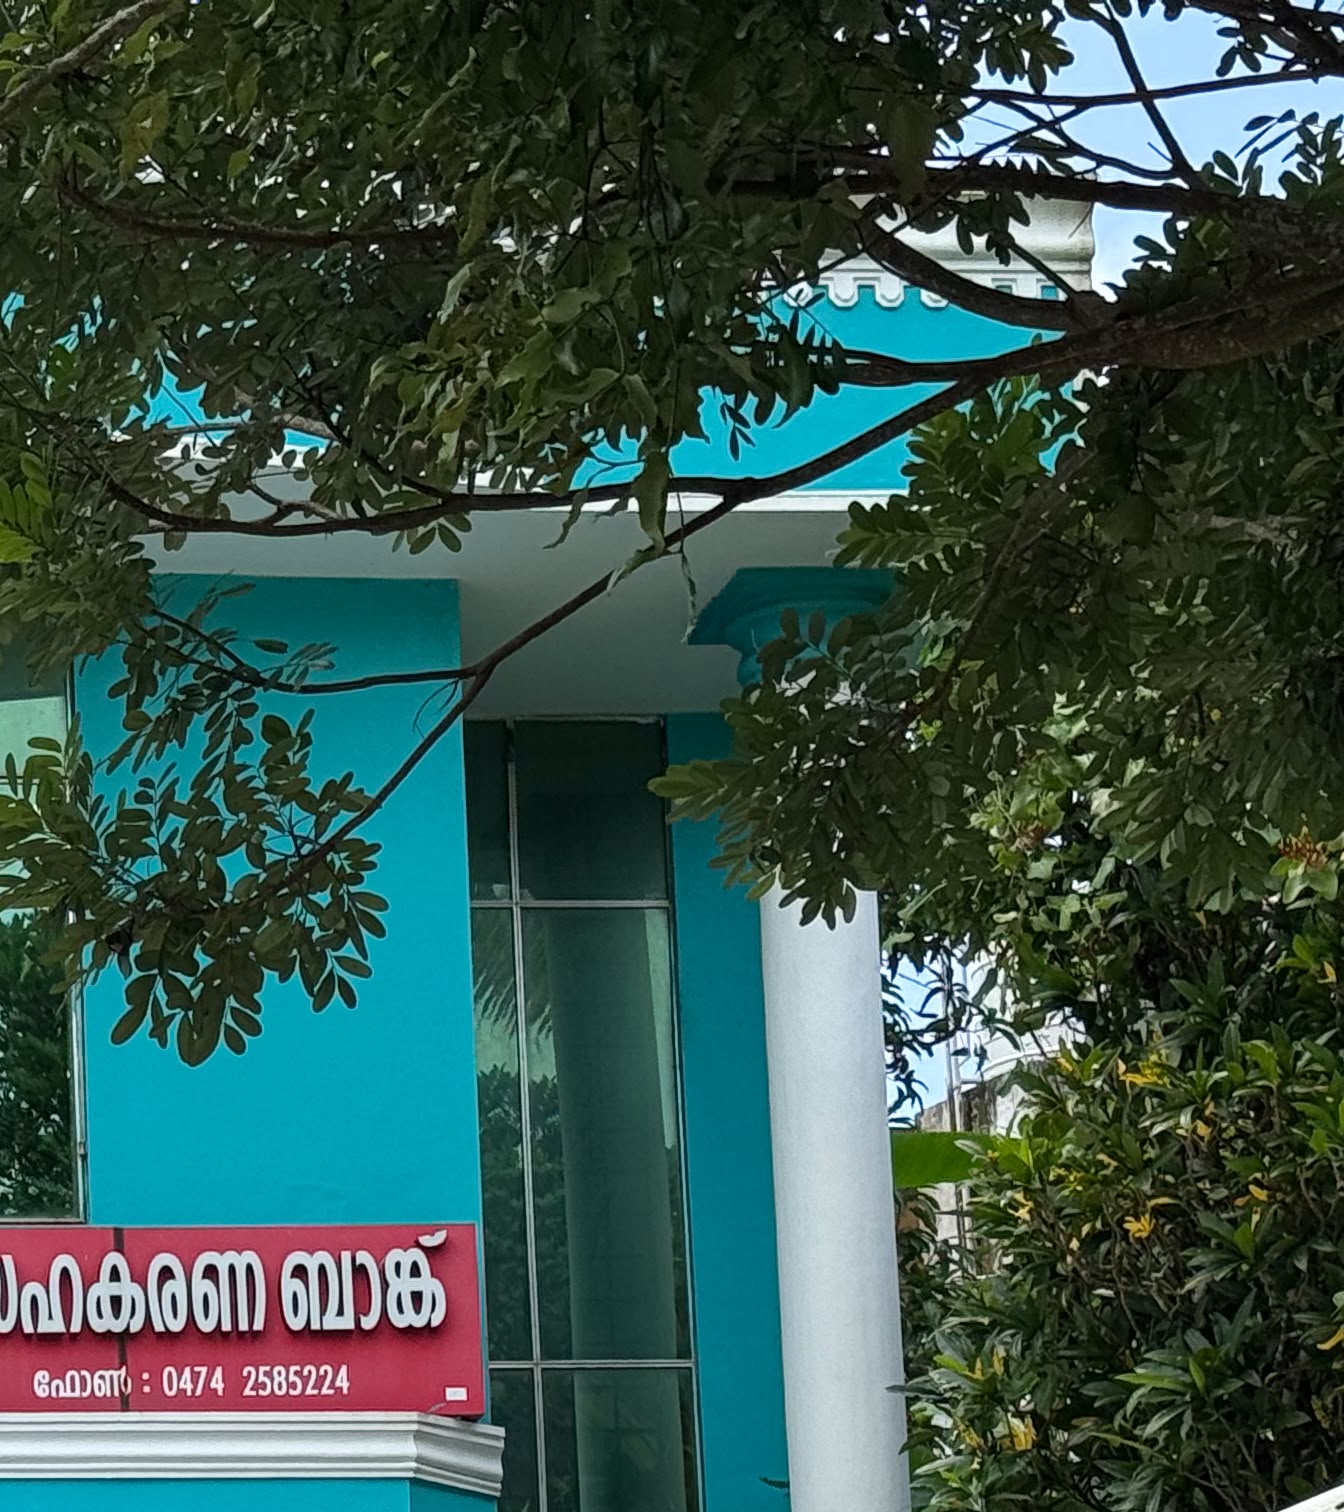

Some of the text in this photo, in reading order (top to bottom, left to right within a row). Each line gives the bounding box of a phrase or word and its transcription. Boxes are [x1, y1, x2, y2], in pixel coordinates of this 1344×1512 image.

[280, 1229, 448, 1331] ബാങ്ക്
[162, 1366, 225, 1398] 0474
[242, 1364, 350, 1397] 2585224
